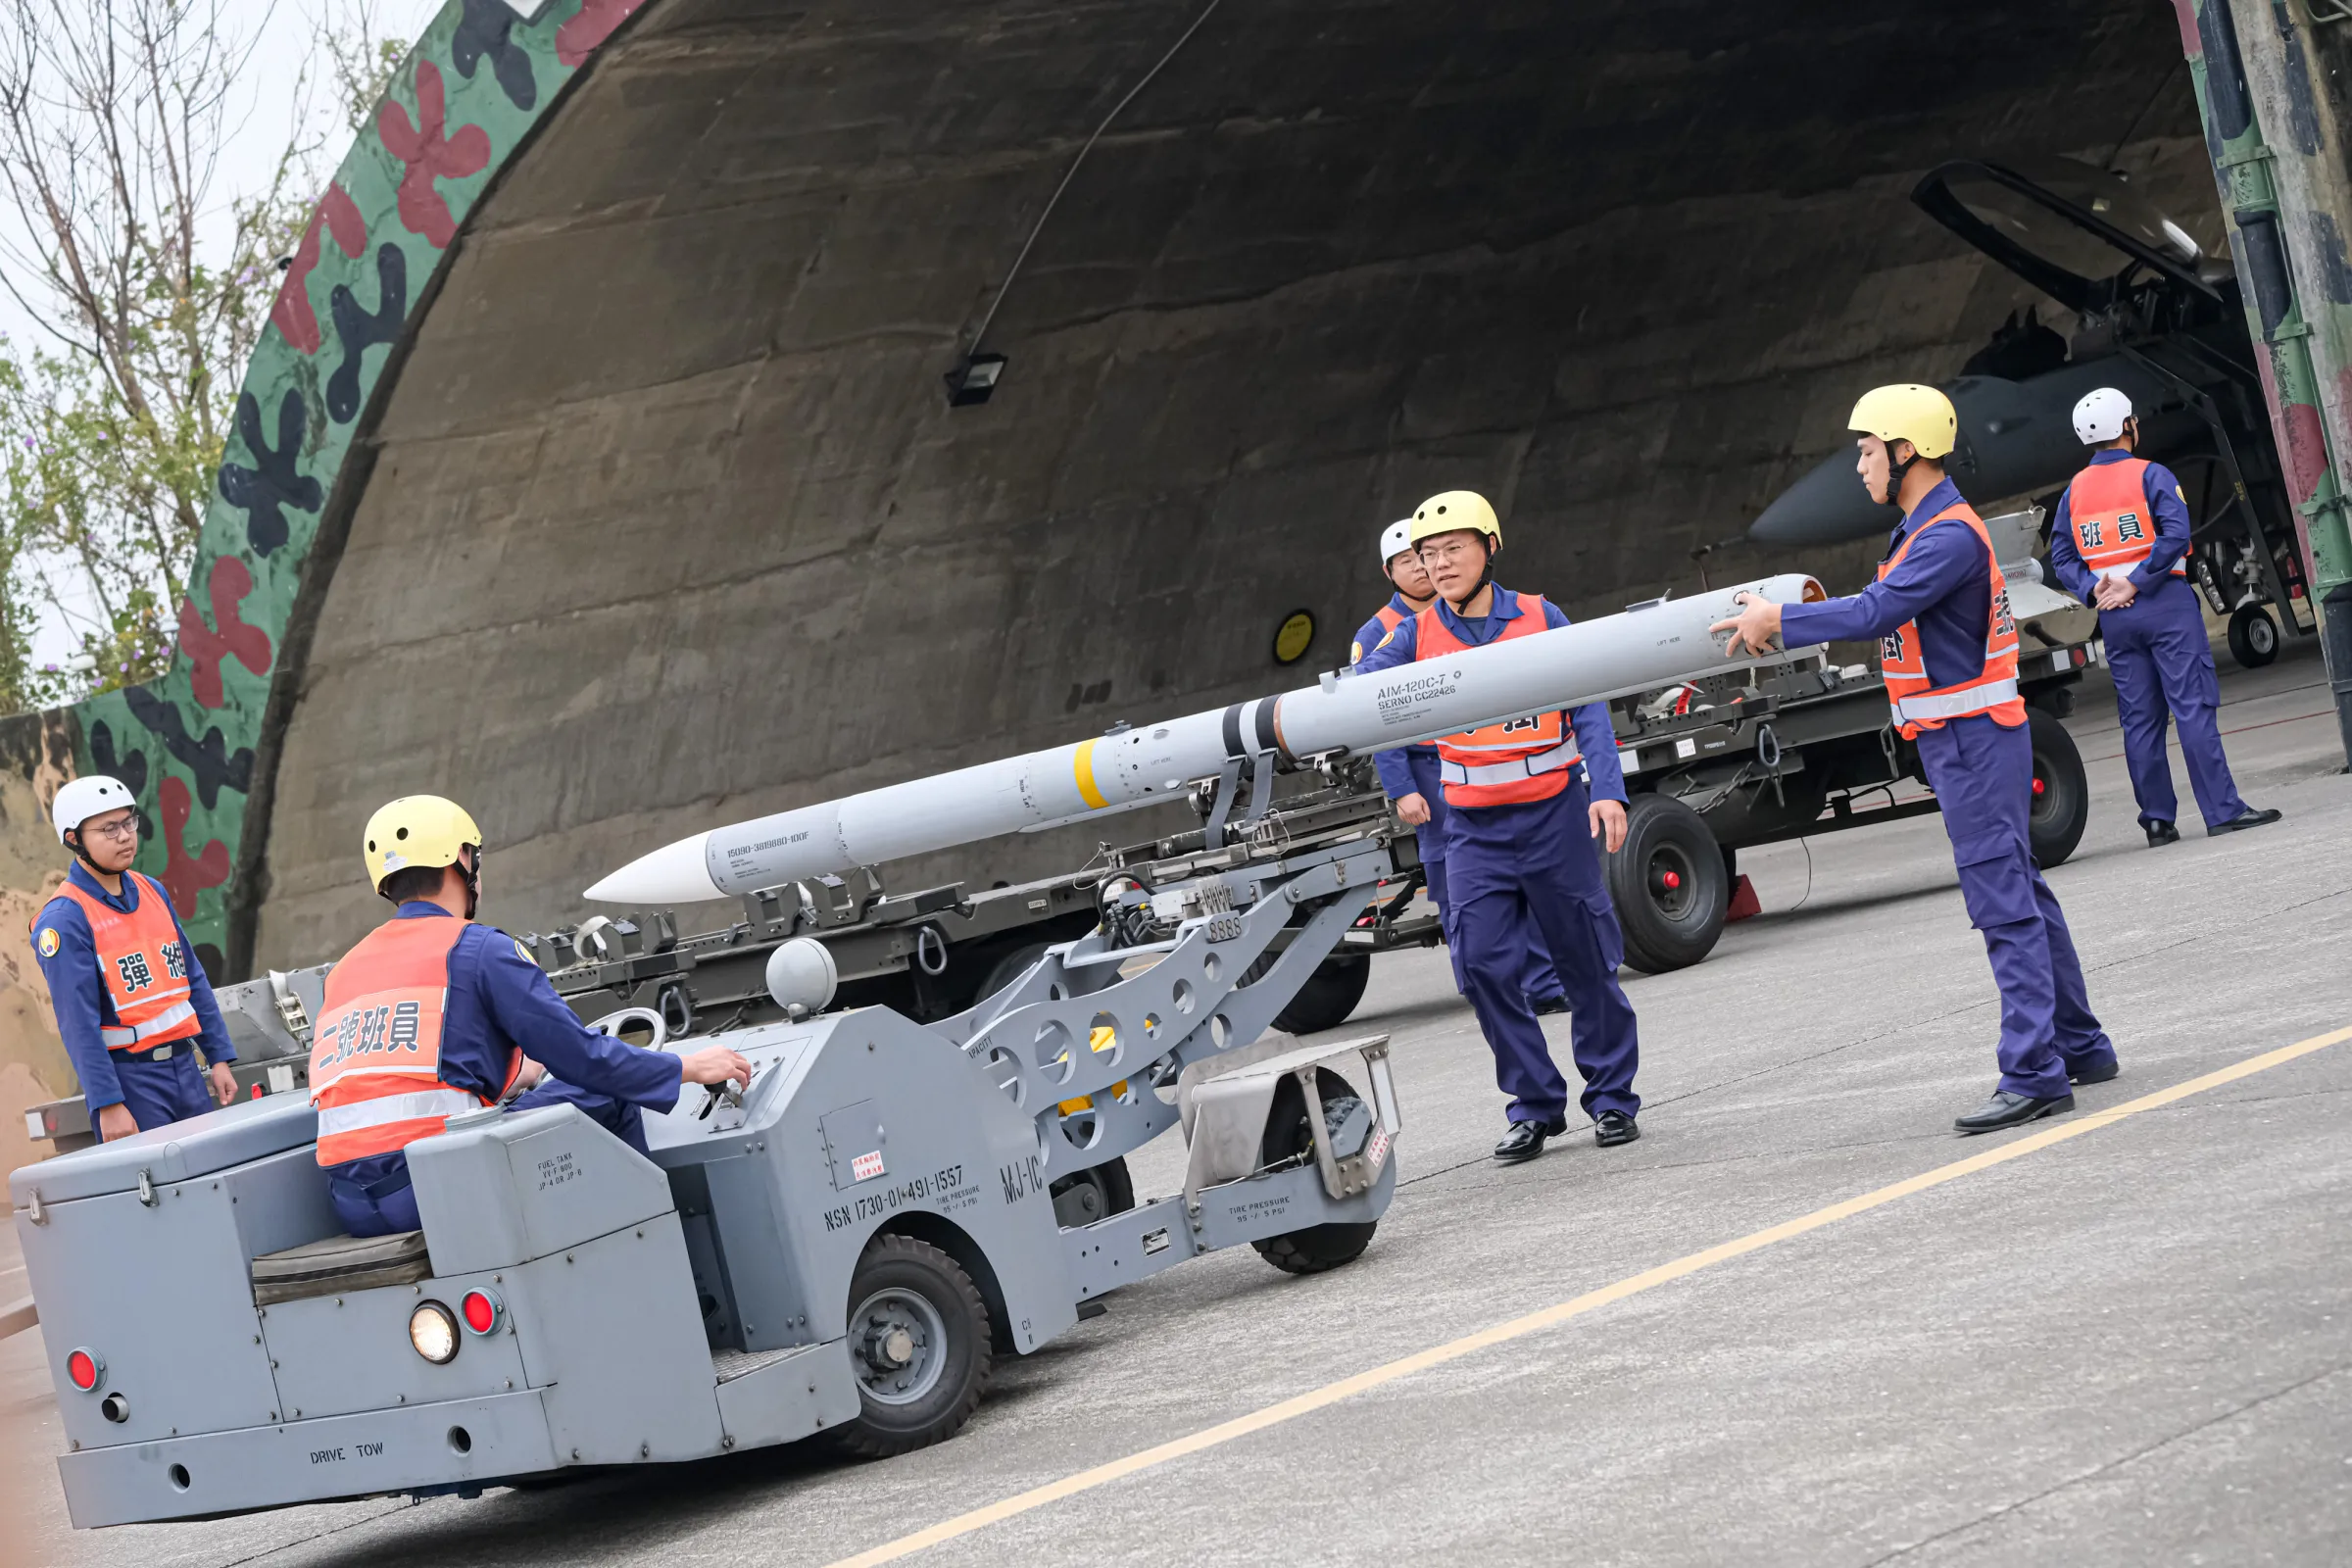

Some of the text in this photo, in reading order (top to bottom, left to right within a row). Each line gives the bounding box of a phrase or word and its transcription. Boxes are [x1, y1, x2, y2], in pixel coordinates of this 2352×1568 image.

[2079, 513, 2144, 549] 班員
[1377, 673, 1446, 700] AIM-120C-7
[1378, 694, 1412, 710] SERNO
[318, 1001, 419, 1069] 二號班員
[537, 1152, 573, 1171] FUEL TANK
[555, 1175, 564, 1185] OR
[1000, 1155, 1043, 1204] MJ-1C
[936, 1184, 980, 1206] TIRE PRESSURE
[967, 1198, 978, 1206] PSI
[1228, 1196, 1291, 1214] TIRE PRESSURE
[824, 1204, 852, 1232] NSN
[1237, 1214, 1248, 1223] 95
[1271, 1206, 1285, 1216] PSI
[310, 1442, 383, 1465] DRIVE TOW
